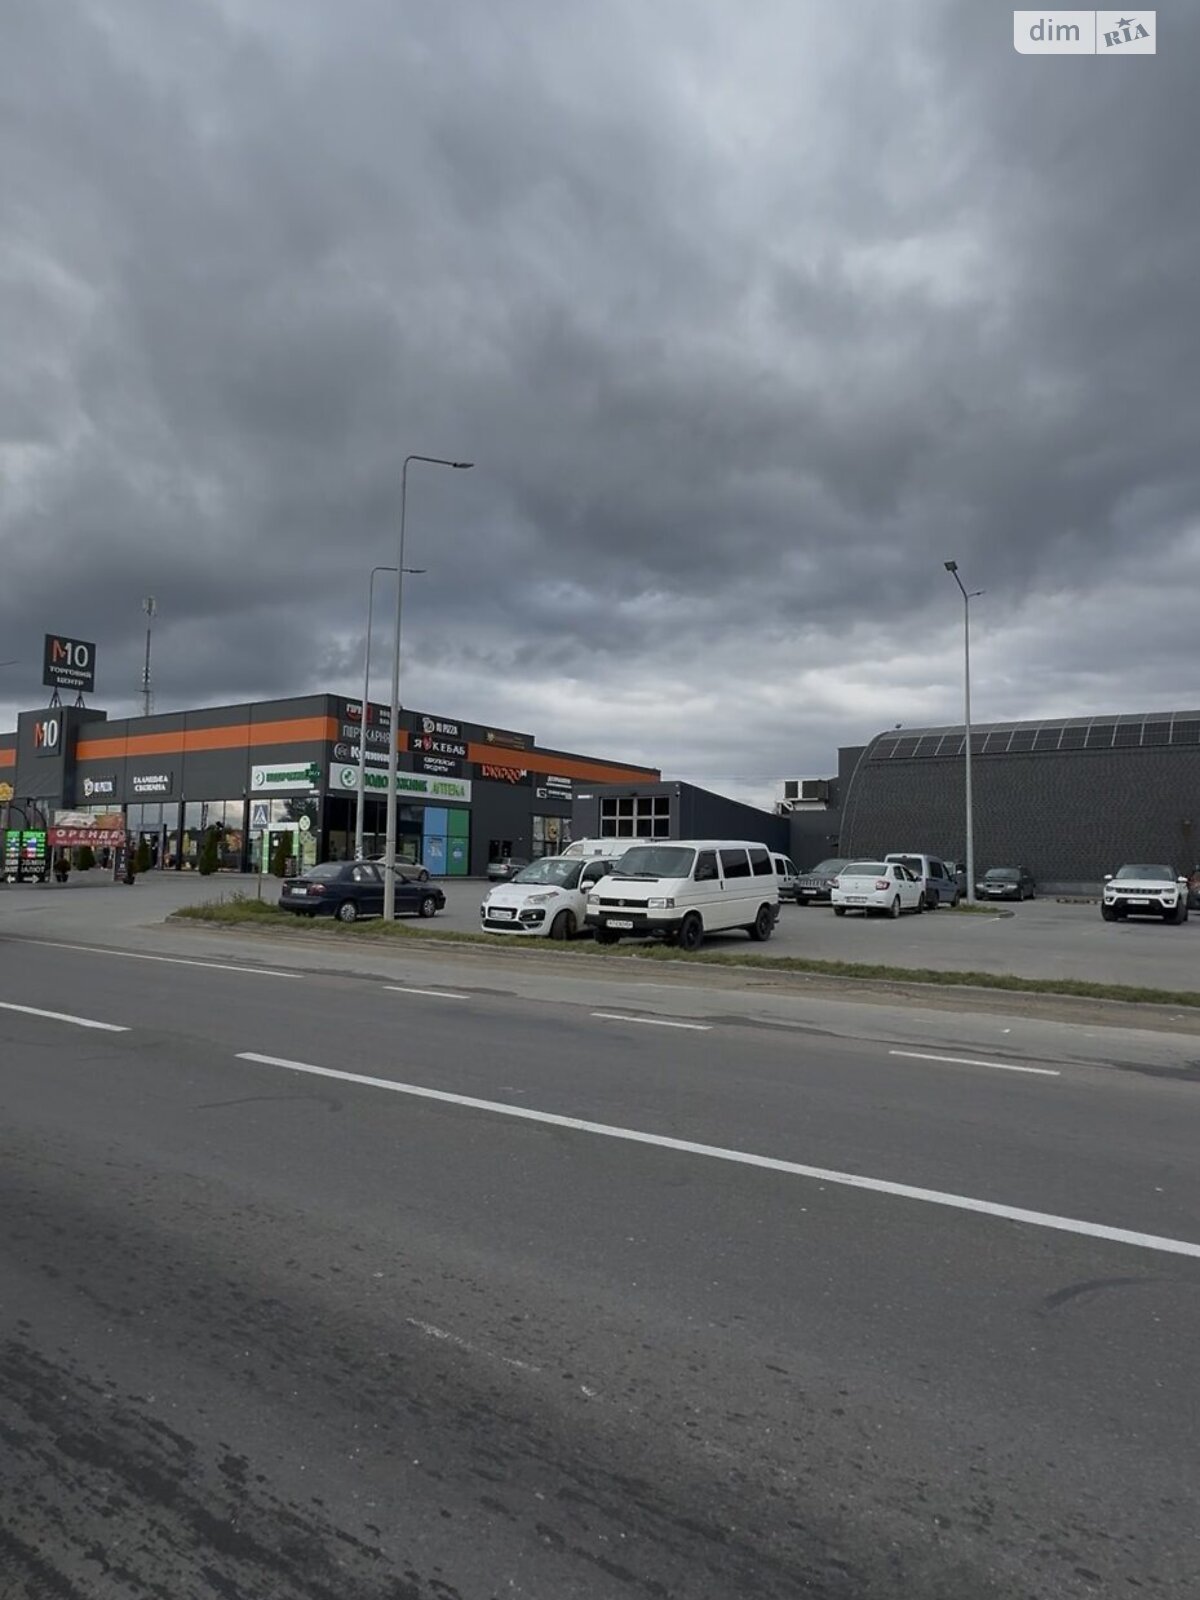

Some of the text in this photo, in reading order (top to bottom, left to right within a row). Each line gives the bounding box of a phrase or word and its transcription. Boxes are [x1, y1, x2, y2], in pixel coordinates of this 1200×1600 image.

[342, 724, 391, 744] ПЕРКАРНЯ
[413, 739, 466, 756] Я КЕБАБ
[364, 773, 465, 797] ПОДООЖНИК АПТЕКА
[56, 829, 119, 839] ОРЕНДА
